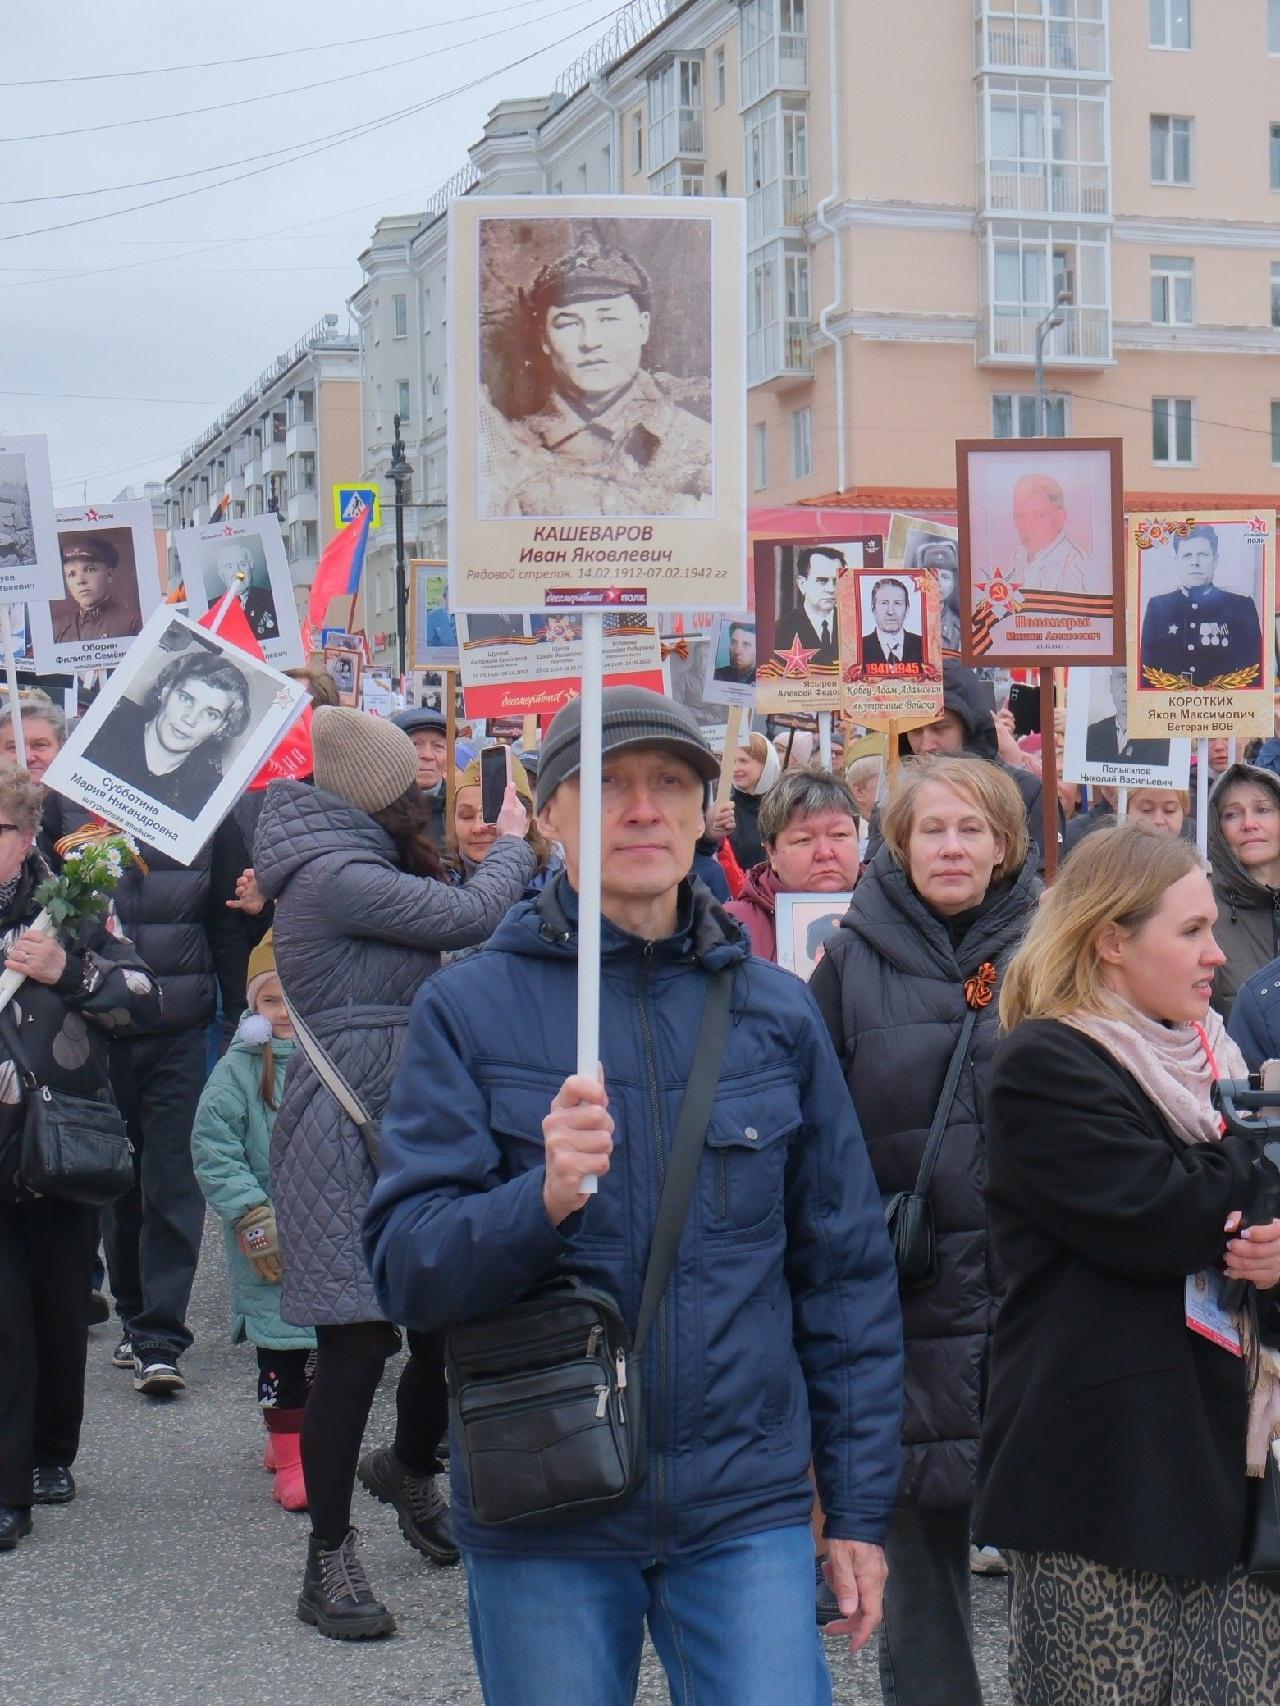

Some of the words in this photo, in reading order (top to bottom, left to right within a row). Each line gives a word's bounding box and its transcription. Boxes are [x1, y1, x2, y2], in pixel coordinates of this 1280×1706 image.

[533, 525, 654, 542] КАШЕВАРОВ
[519, 547, 566, 563] Иван
[571, 547, 673, 563] Яковлевич
[466, 569, 515, 580] Рядовой
[865, 662, 920, 674] 1941-1945
[815, 688, 840, 697] Федо
[1168, 696, 1233, 707] КОРОТКИХ
[1148, 710, 1177, 719] Яков
[1180, 709, 1256, 719] Максимович
[1167, 723, 1209, 732] Ветеран
[1212, 722, 1233, 731] ВОВ
[1080, 773, 1118, 784] Николай
[1119, 775, 1173, 787] Васильевич
[102, 777, 160, 815] Субботина
[70, 772, 107, 799] Мария
[107, 794, 180, 842] Никандровна
